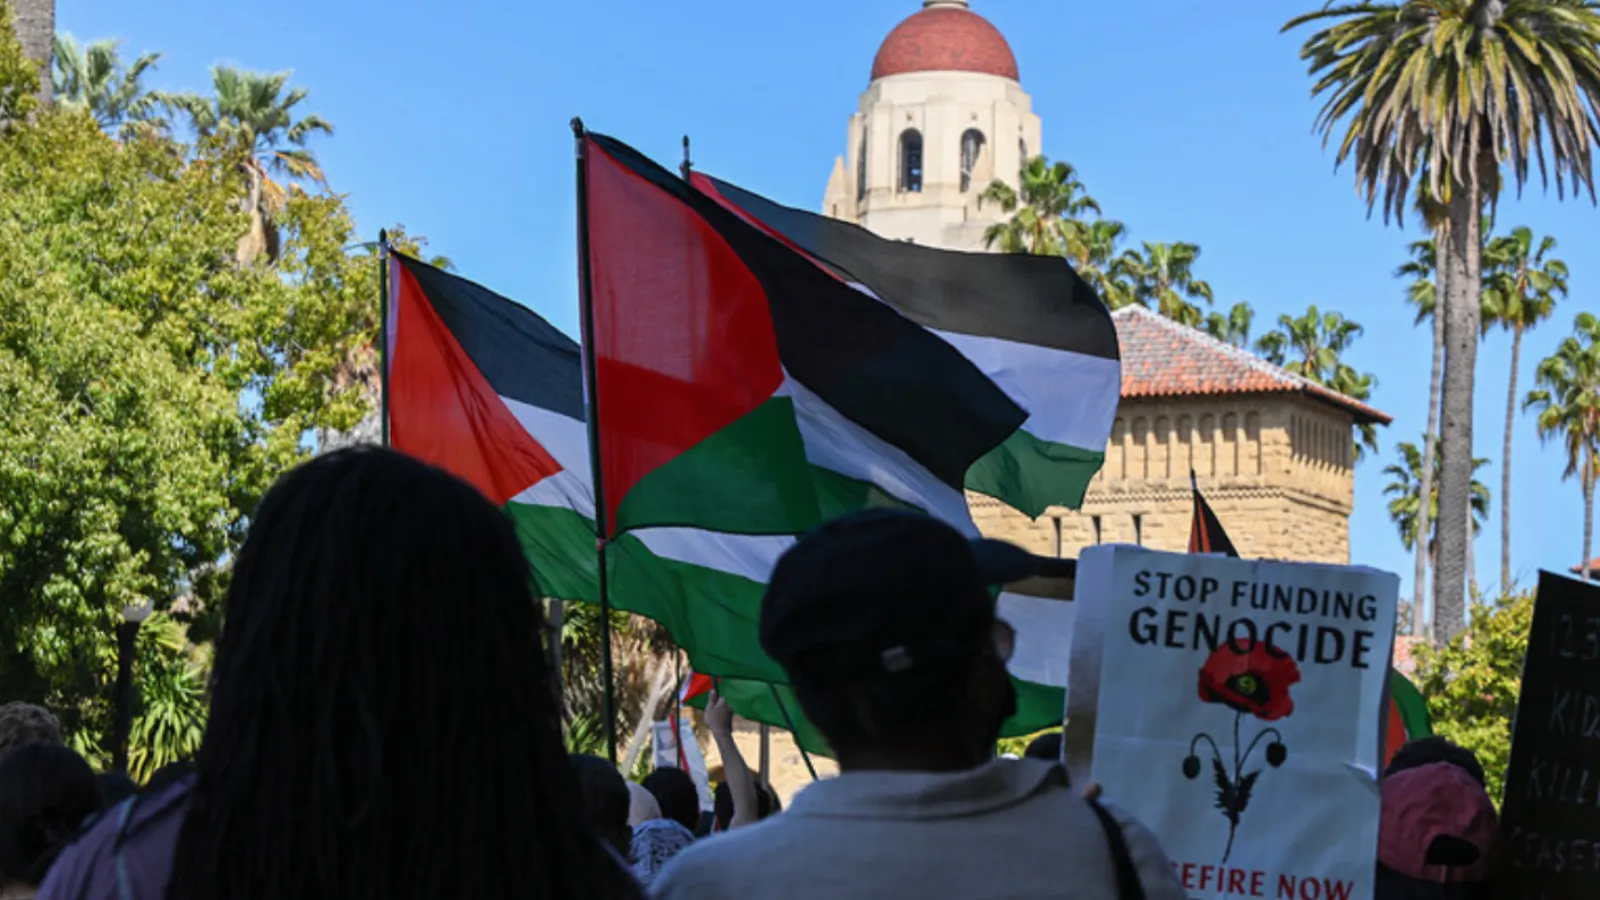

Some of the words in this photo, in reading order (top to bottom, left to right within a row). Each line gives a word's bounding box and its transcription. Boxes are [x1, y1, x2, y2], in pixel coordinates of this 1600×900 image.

[1133, 570, 1219, 604] STOP
[1230, 580, 1378, 622] FUNDING
[1128, 606, 1376, 669] GENOCIDE
[1548, 686, 1600, 739] KID
[1527, 756, 1600, 807] KILL
[1170, 861, 1266, 898] EFIRE
[1277, 873, 1354, 900] NOW
